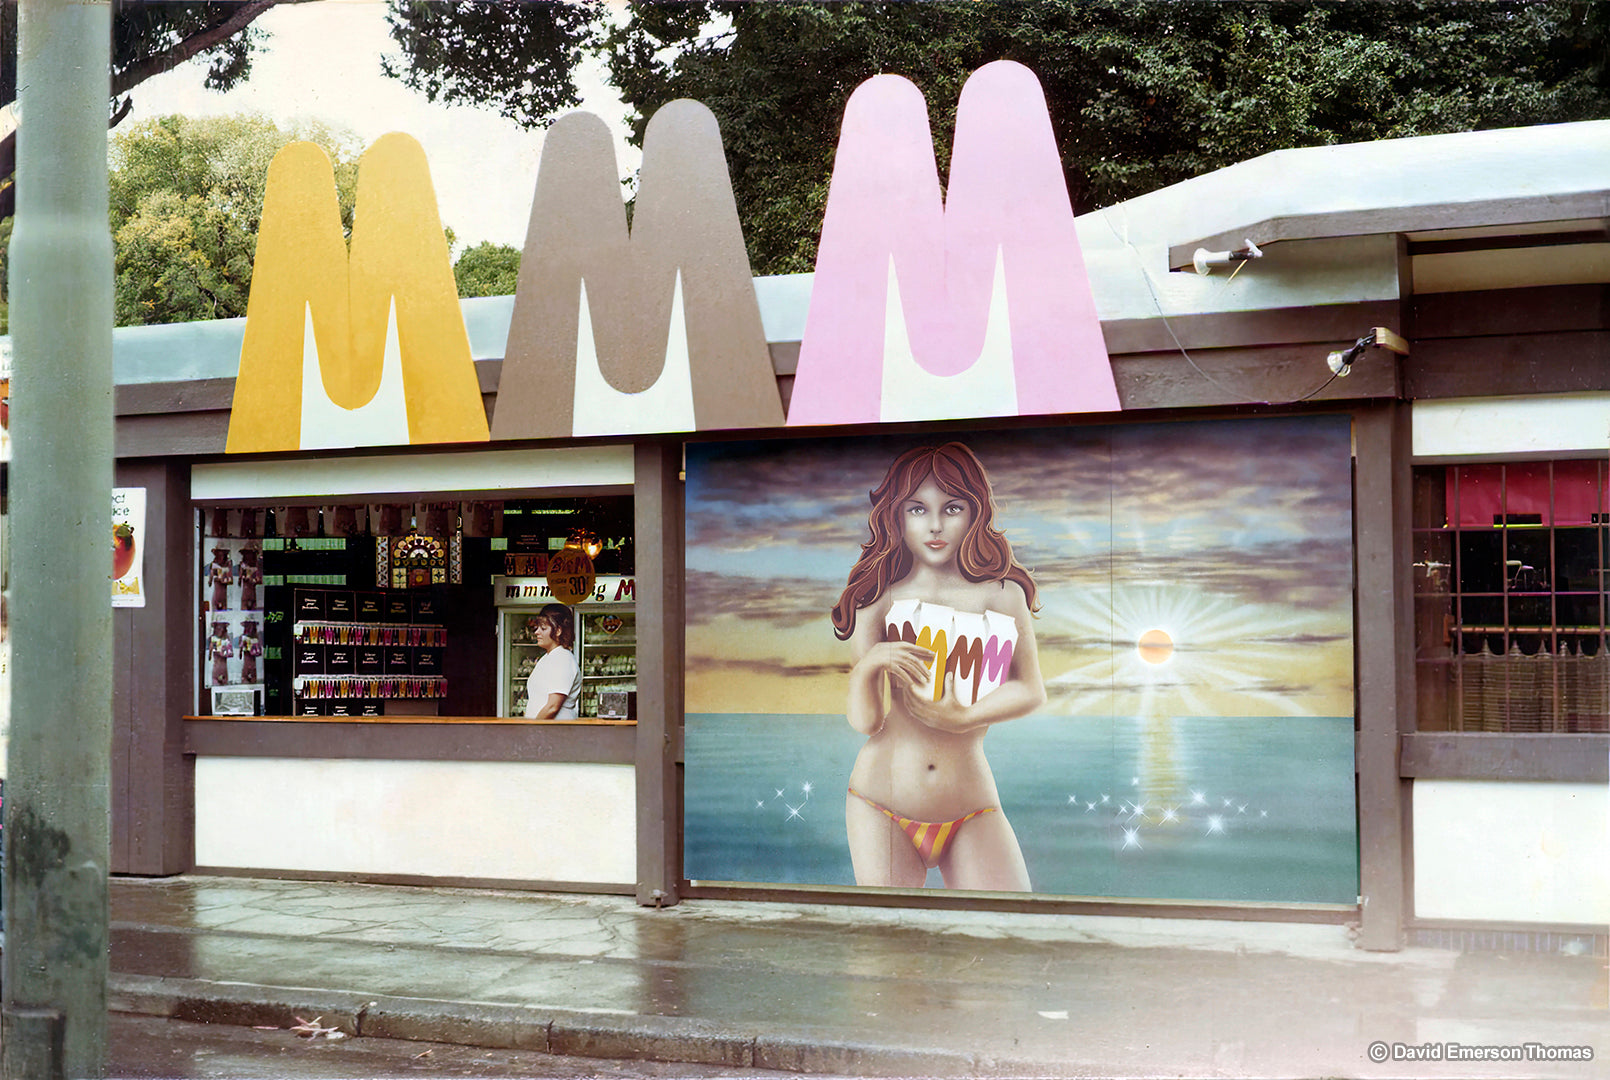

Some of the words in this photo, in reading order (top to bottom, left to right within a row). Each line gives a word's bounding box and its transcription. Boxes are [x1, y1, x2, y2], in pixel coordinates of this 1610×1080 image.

[226, 131, 489, 454] M
[490, 98, 786, 441] M
[786, 59, 1121, 426] M
